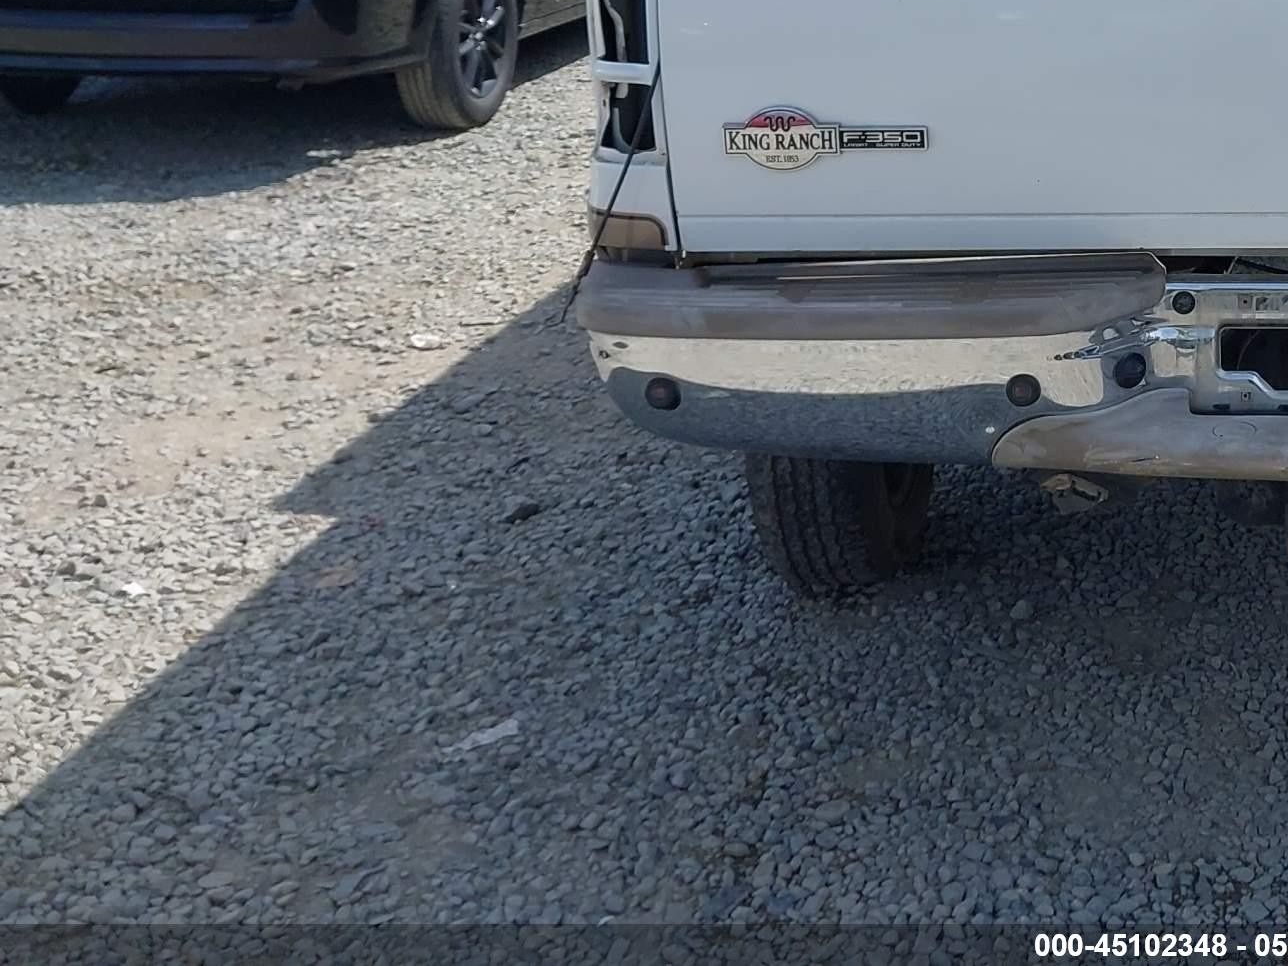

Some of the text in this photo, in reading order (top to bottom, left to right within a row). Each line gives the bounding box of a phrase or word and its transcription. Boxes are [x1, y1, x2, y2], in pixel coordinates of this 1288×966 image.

[728, 130, 835, 151] KING RANCH
[842, 131, 921, 143] F-350
